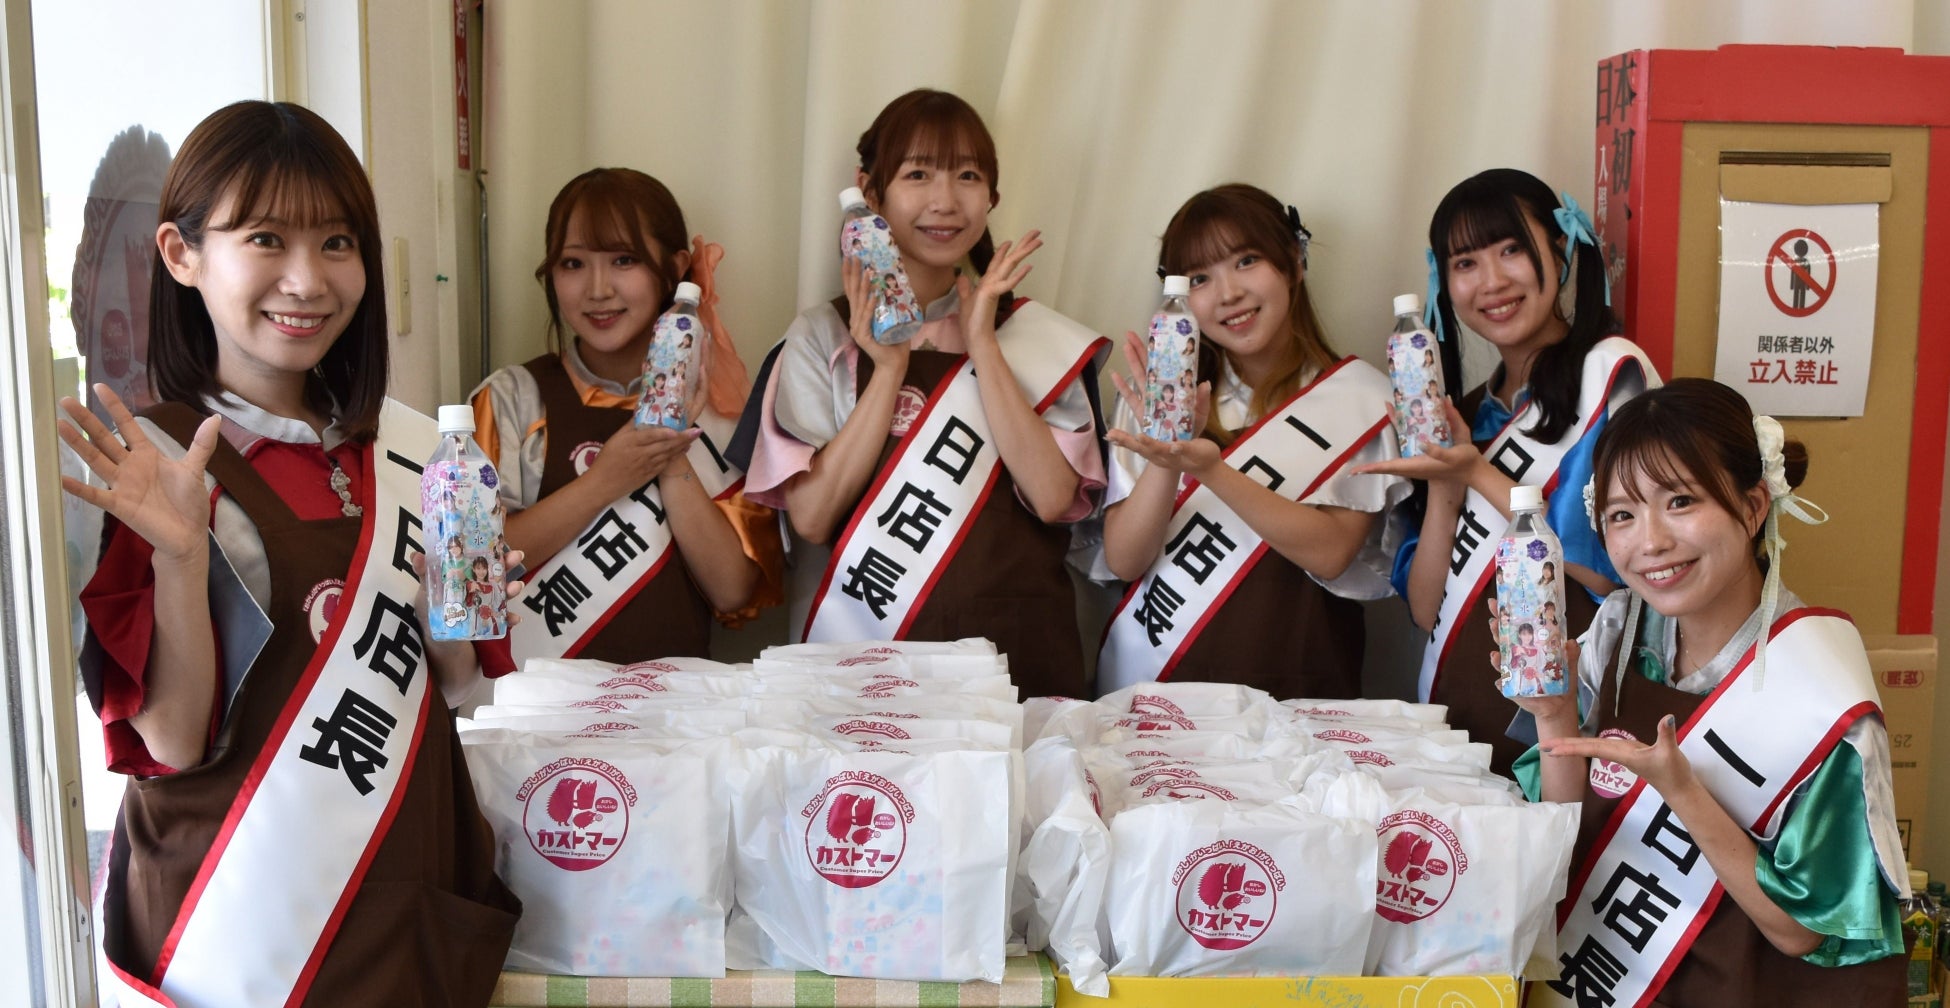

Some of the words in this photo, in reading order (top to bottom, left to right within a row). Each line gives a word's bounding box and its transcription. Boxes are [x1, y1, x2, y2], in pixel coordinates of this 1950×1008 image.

[1758, 335, 1834, 354] 関係者以外
[1748, 358, 1838, 385] 立入禁止
[841, 367, 985, 621] 日店長
[1592, 768, 1632, 788] カストマー
[537, 829, 618, 850] カストマー
[816, 846, 895, 867] カストマー
[1188, 908, 1264, 931] カストマー
